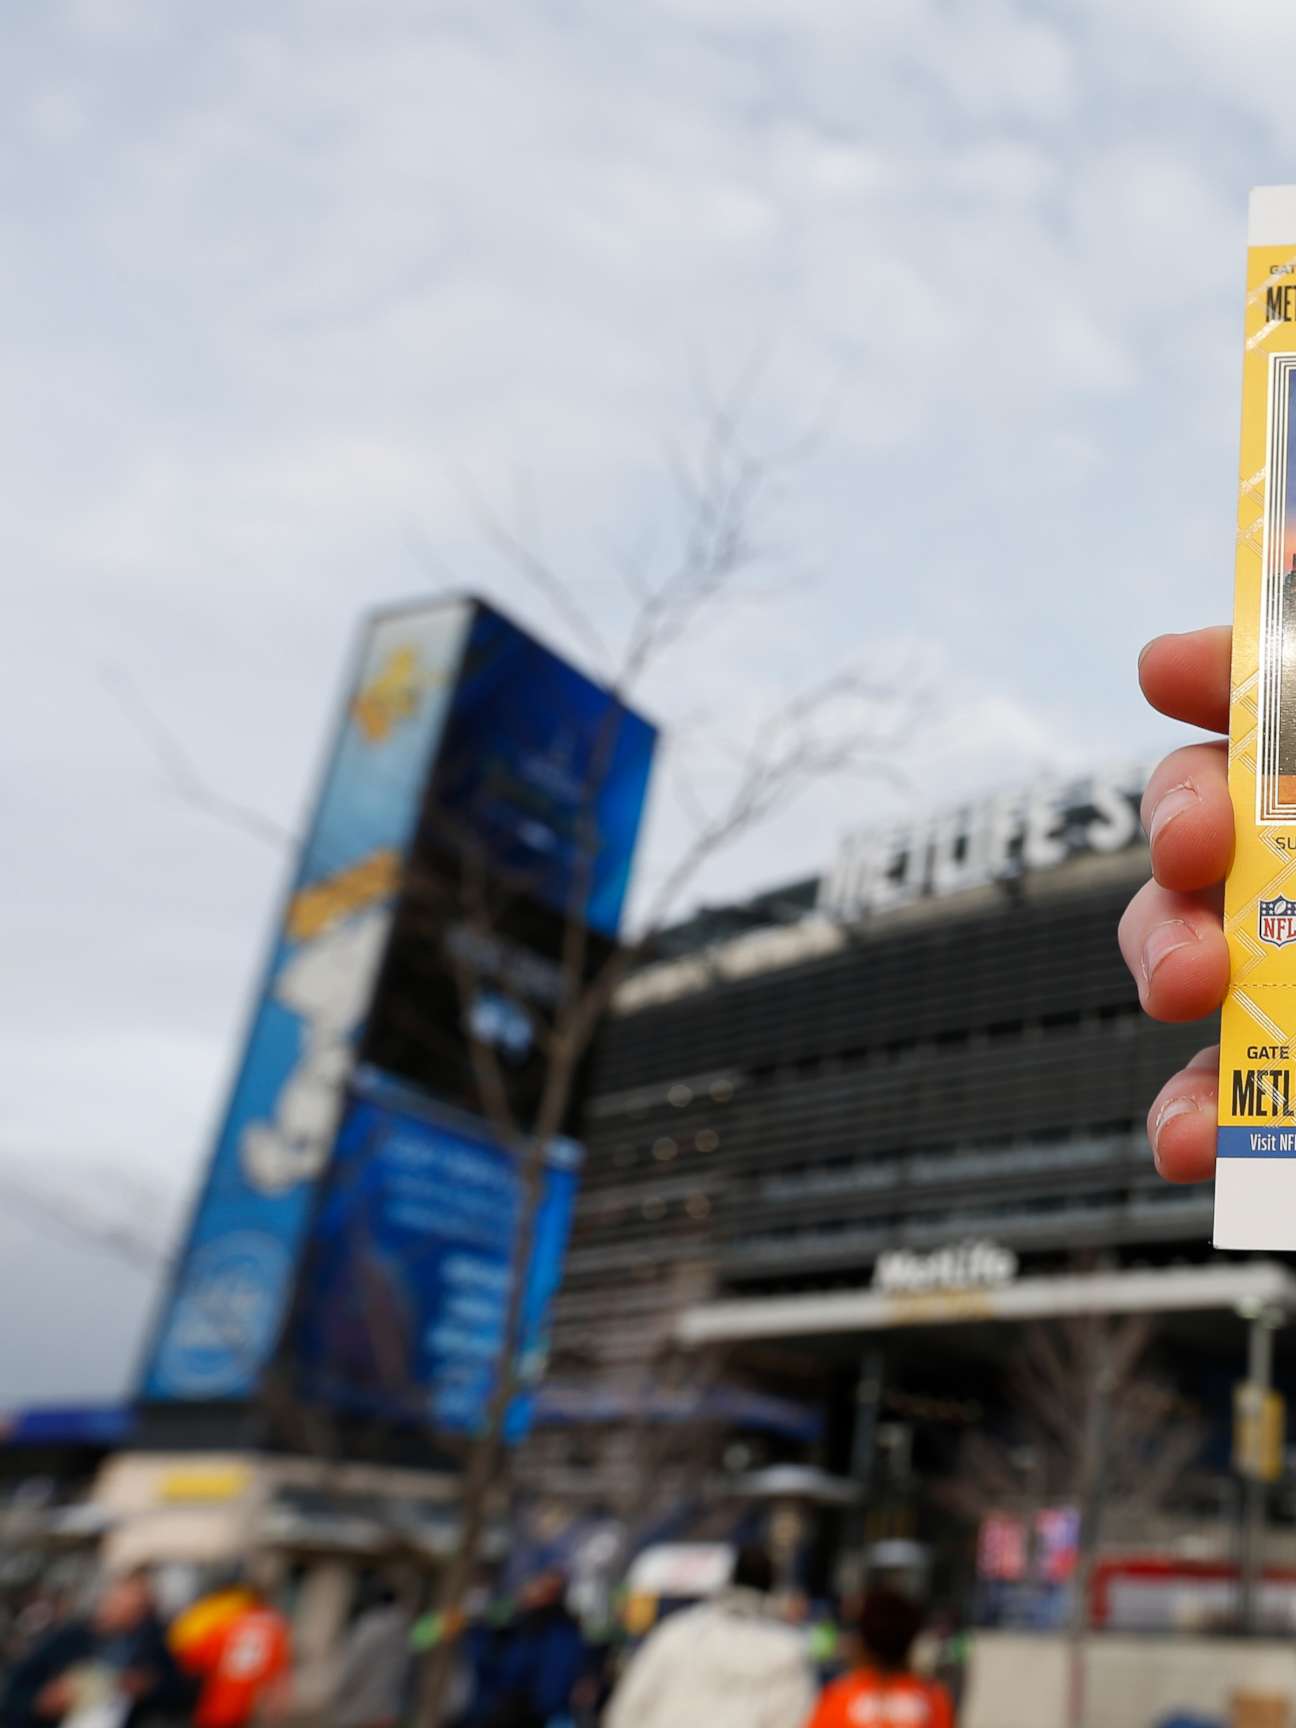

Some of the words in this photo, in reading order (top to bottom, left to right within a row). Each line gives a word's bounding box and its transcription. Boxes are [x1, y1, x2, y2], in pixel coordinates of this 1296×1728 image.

[1263, 916, 1296, 941] NFL
[1247, 1046, 1290, 1060] GATE
[1250, 1133, 1277, 1151] Visit
